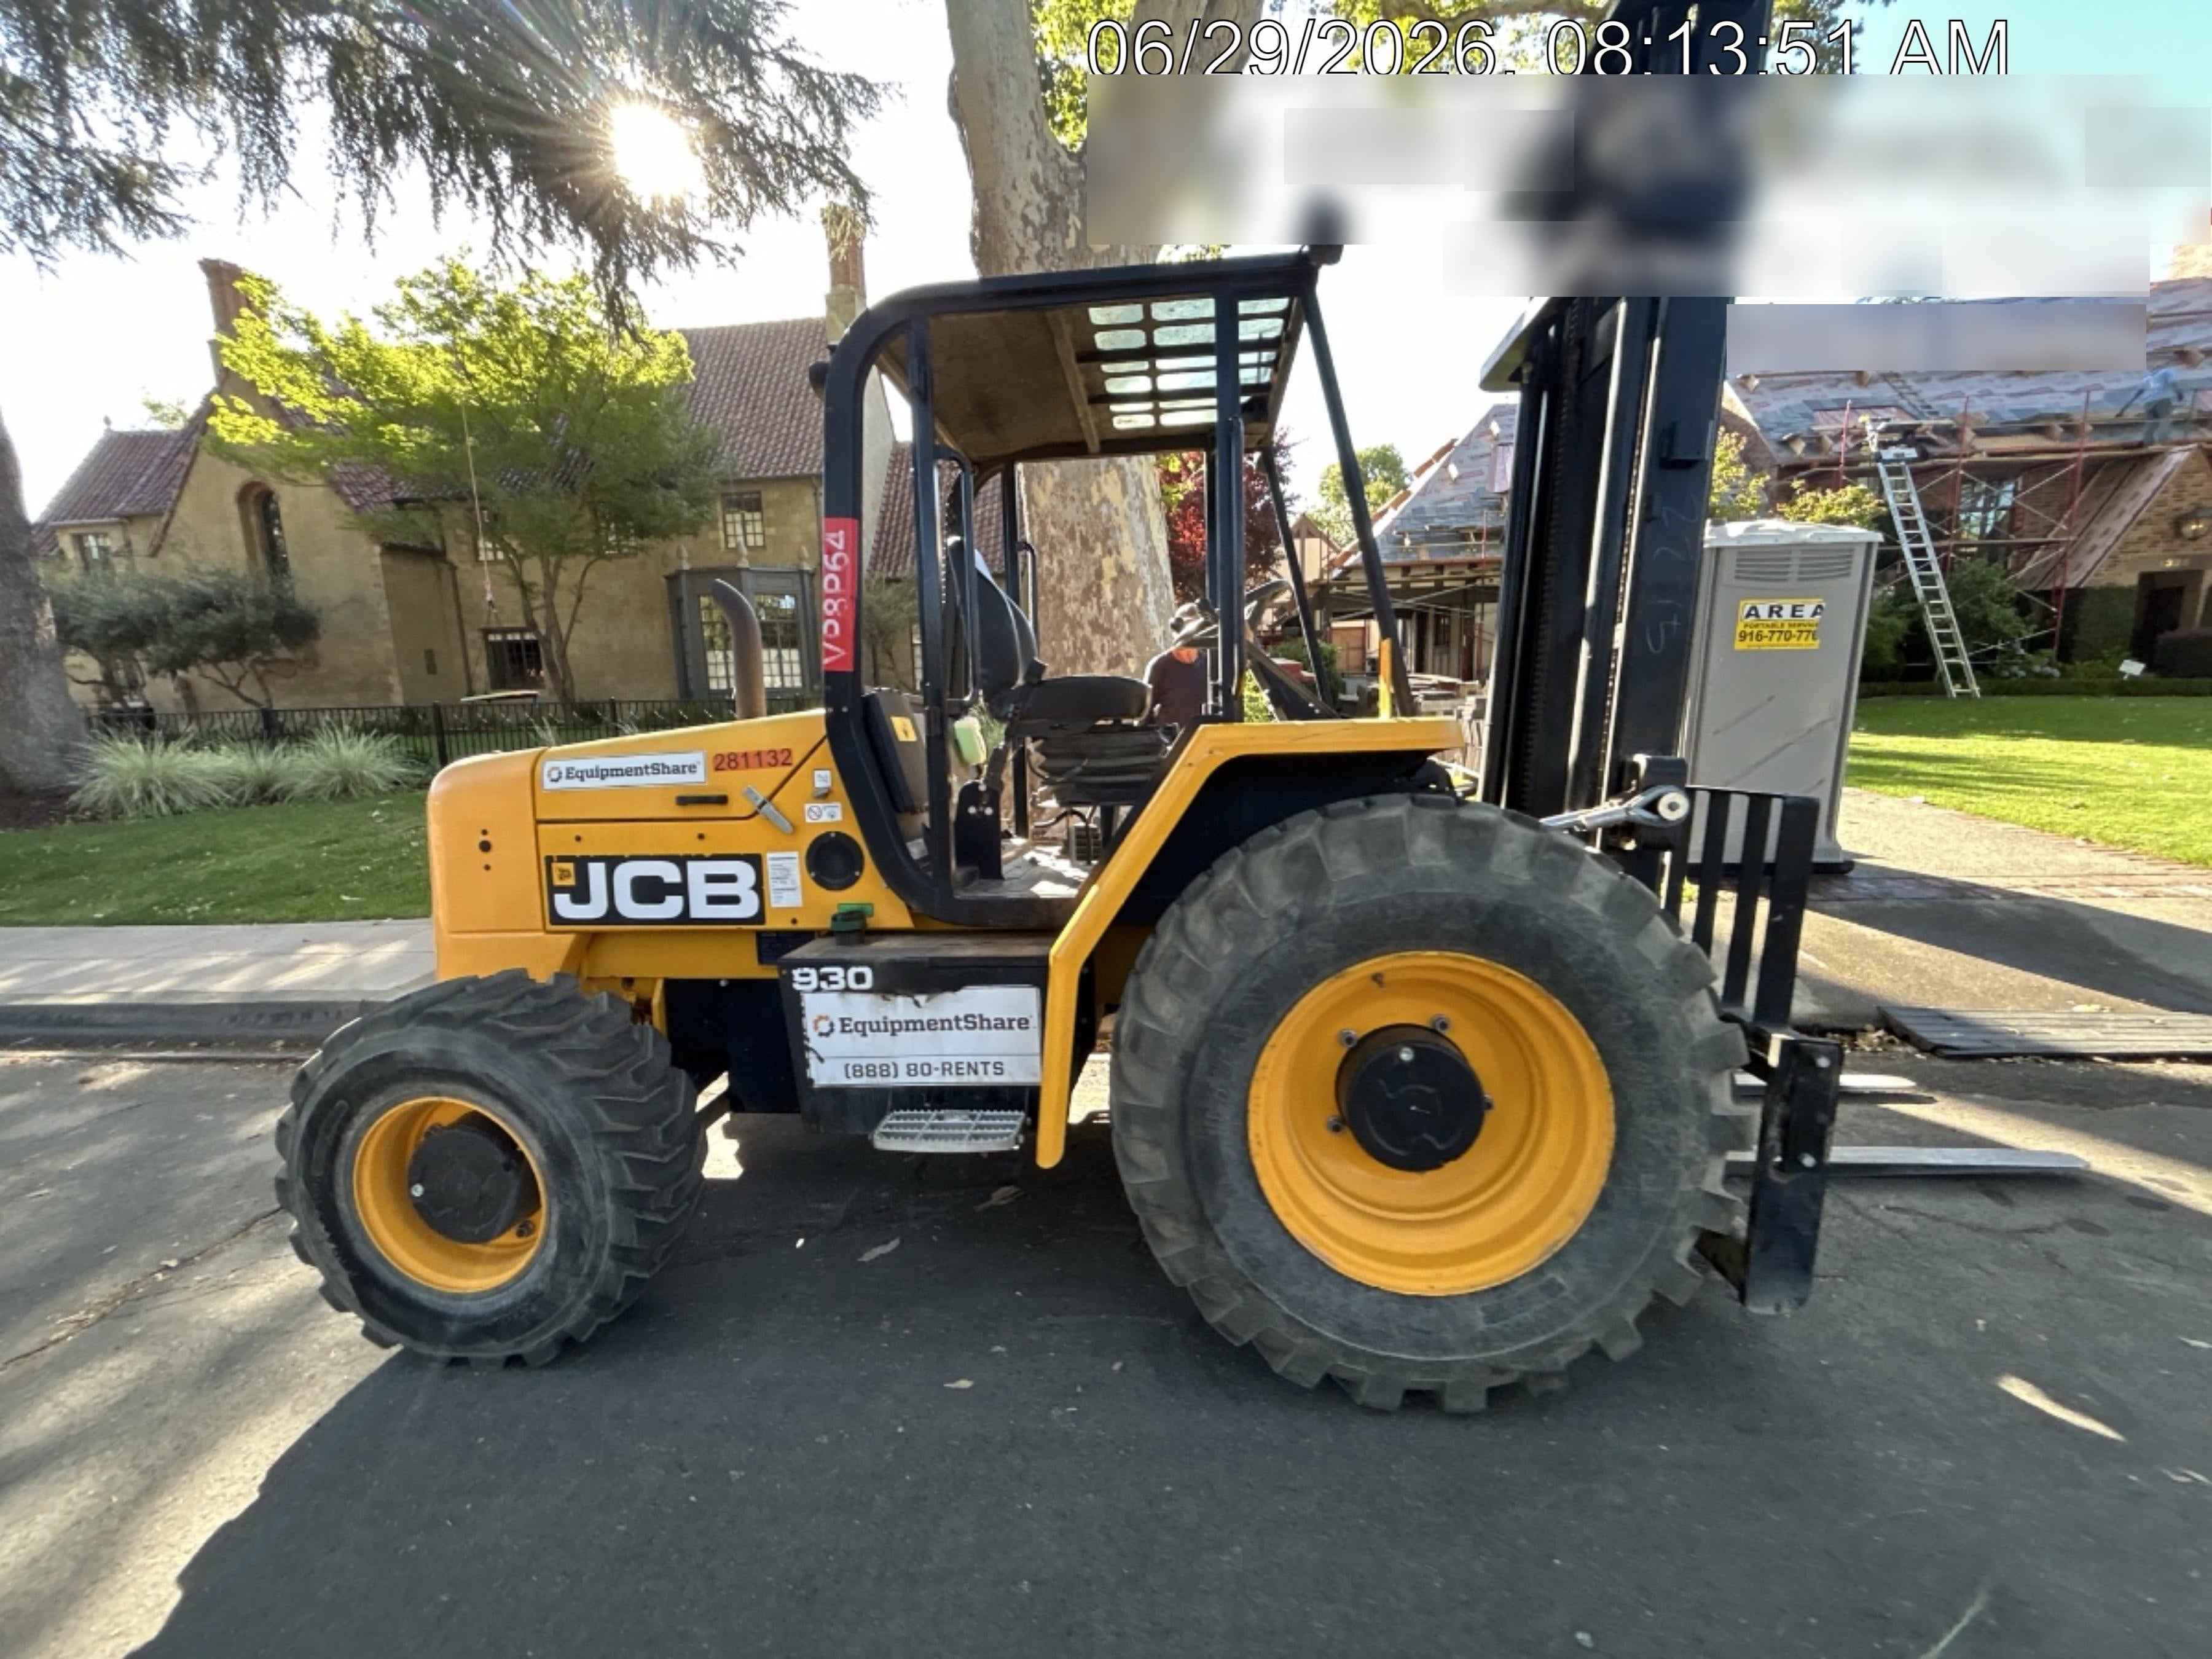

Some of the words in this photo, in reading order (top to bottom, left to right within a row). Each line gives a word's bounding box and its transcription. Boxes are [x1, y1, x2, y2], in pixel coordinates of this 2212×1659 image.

[1744, 604, 1825, 619] AREA
[713, 748, 793, 772] 281132
[565, 763, 698, 782] EquipmentShare
[554, 860, 761, 919] JCB
[791, 965, 874, 992] 930
[839, 1013, 1030, 1037] EquipmentShare
[844, 1061, 900, 1079] (888)
[906, 1061, 1005, 1077] 80-RENTS
